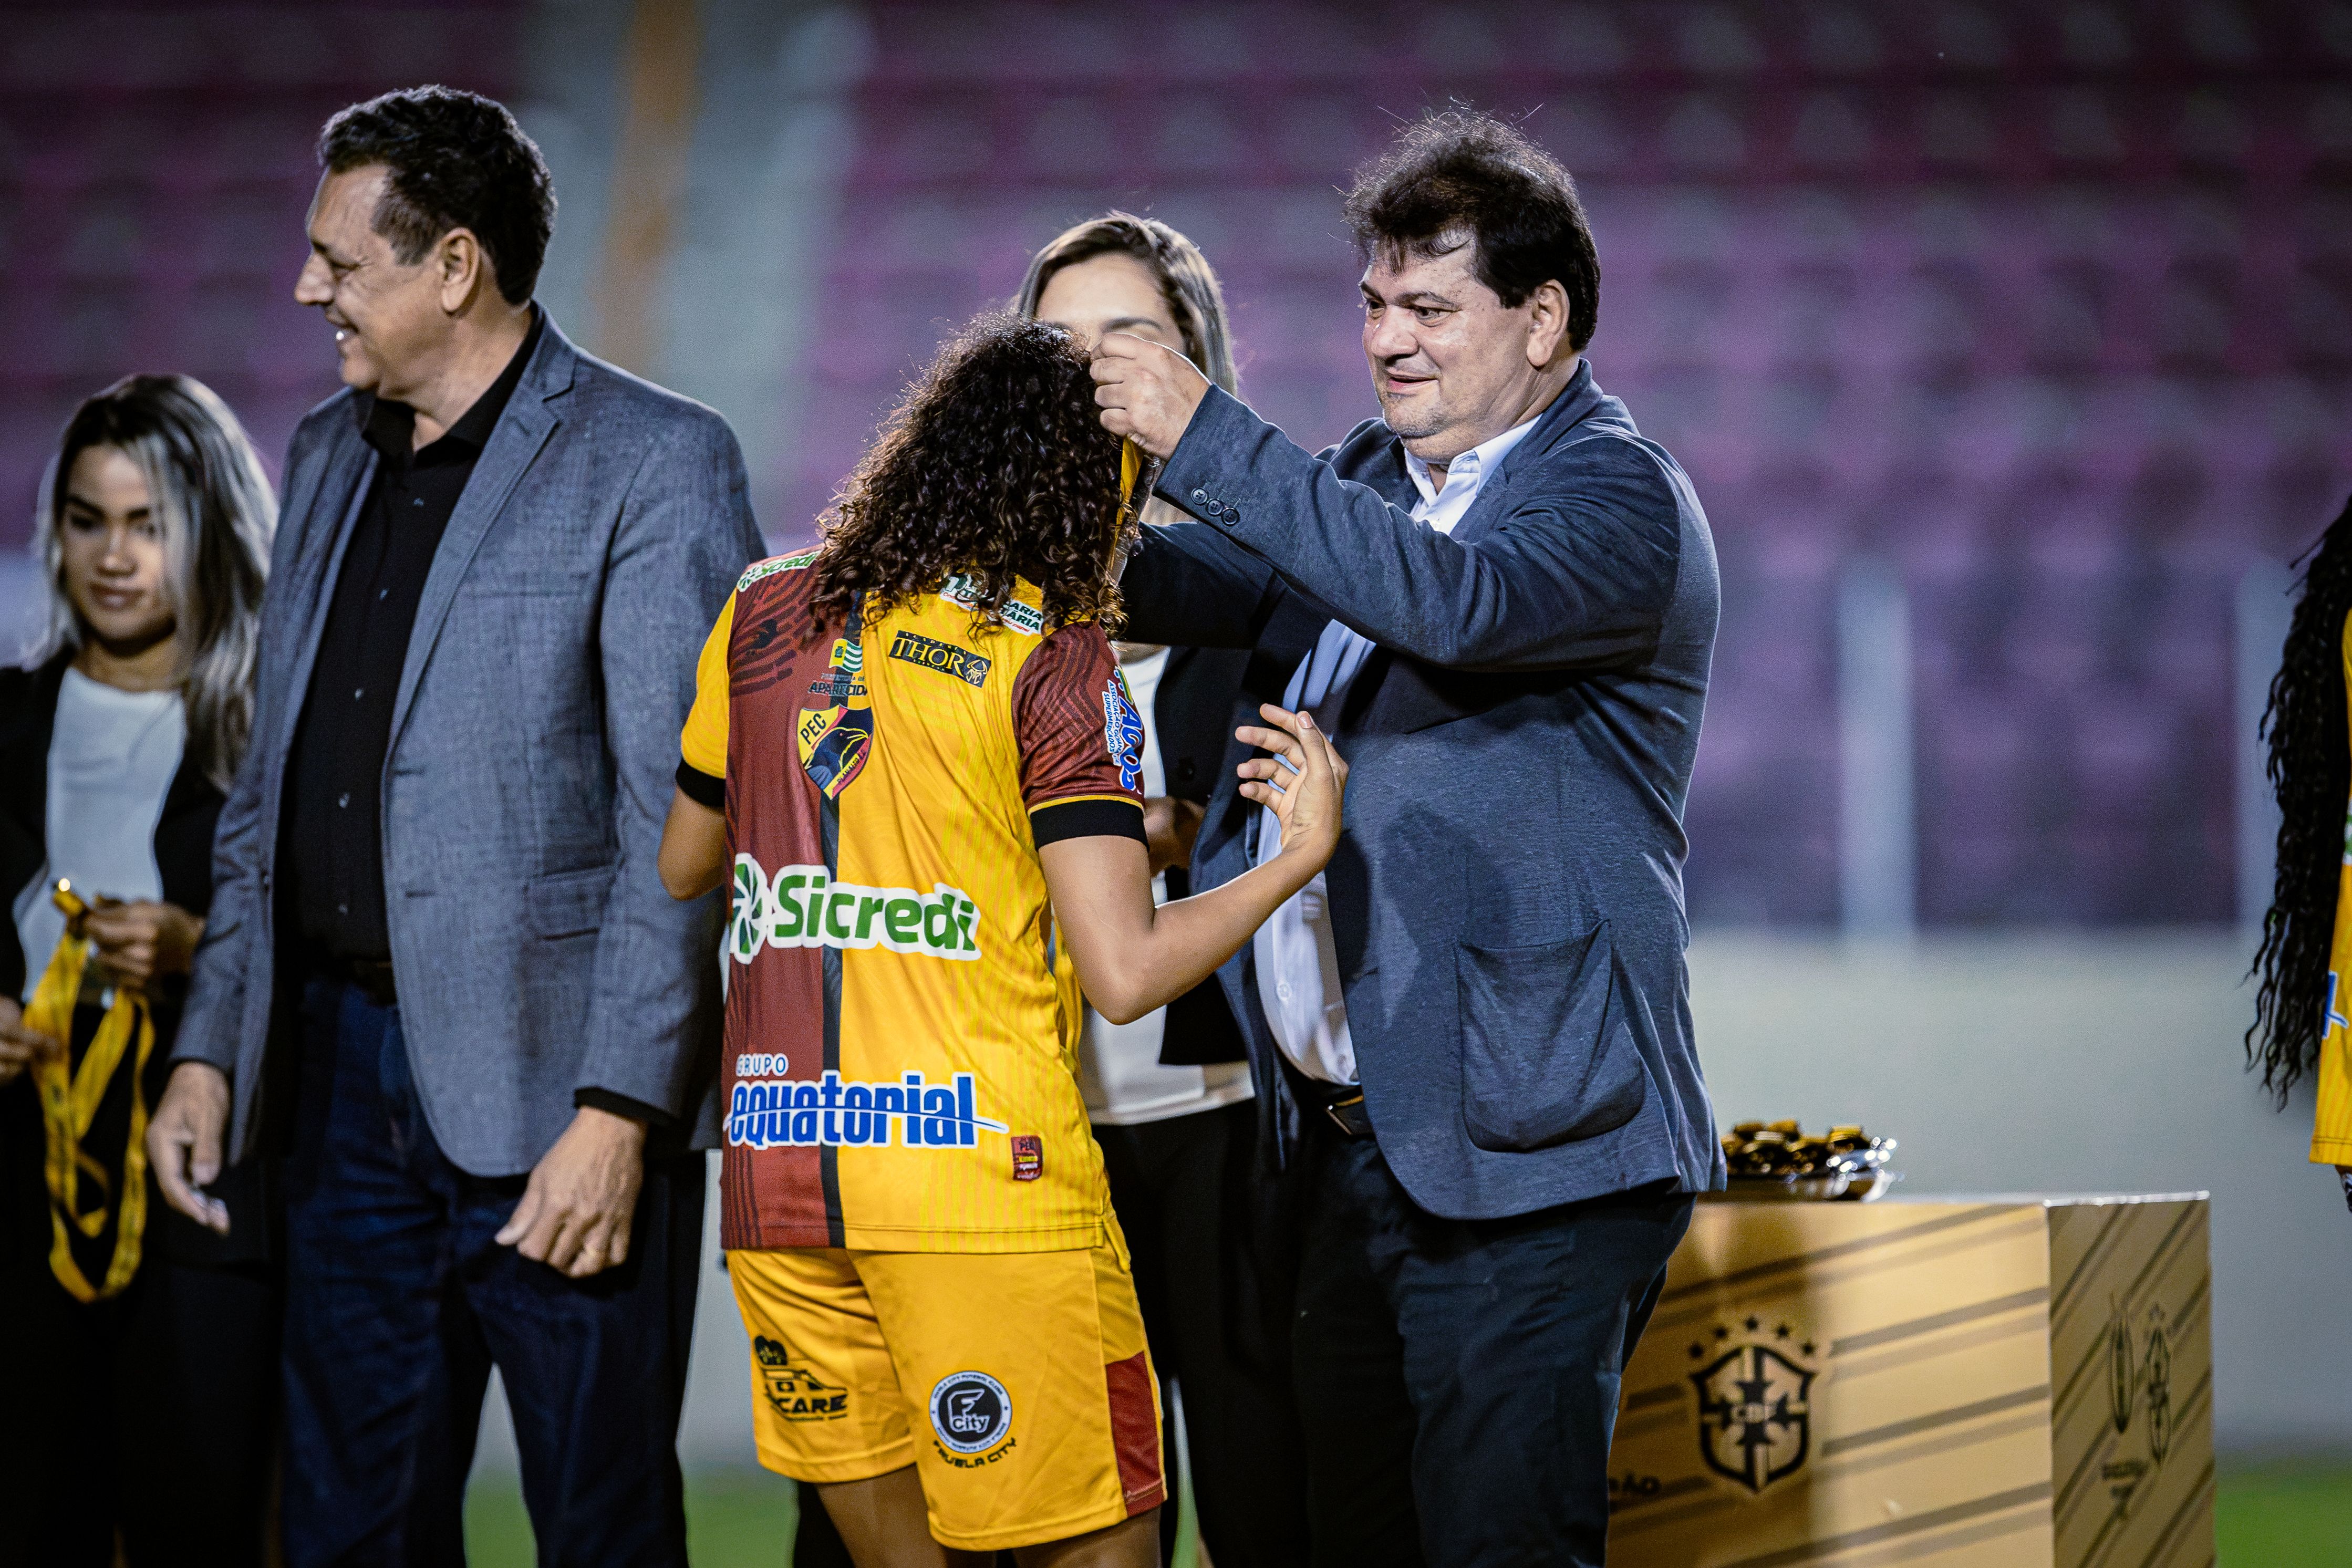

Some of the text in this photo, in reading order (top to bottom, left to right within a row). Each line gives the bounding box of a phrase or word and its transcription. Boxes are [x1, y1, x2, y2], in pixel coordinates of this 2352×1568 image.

[1008, 602, 1042, 621] ARIA
[895, 637, 965, 677] THOR
[1104, 693, 1115, 753] SUPERMERCADOS
[1109, 681, 1121, 730] ASSOCIAÇÃO
[800, 713, 827, 745] PEC
[774, 874, 976, 951] Sicredi
[737, 1056, 786, 1074] GRUPO
[730, 1075, 975, 1146] equatorial
[952, 1414, 988, 1431] City
[987, 1437, 1017, 1463] CITY
